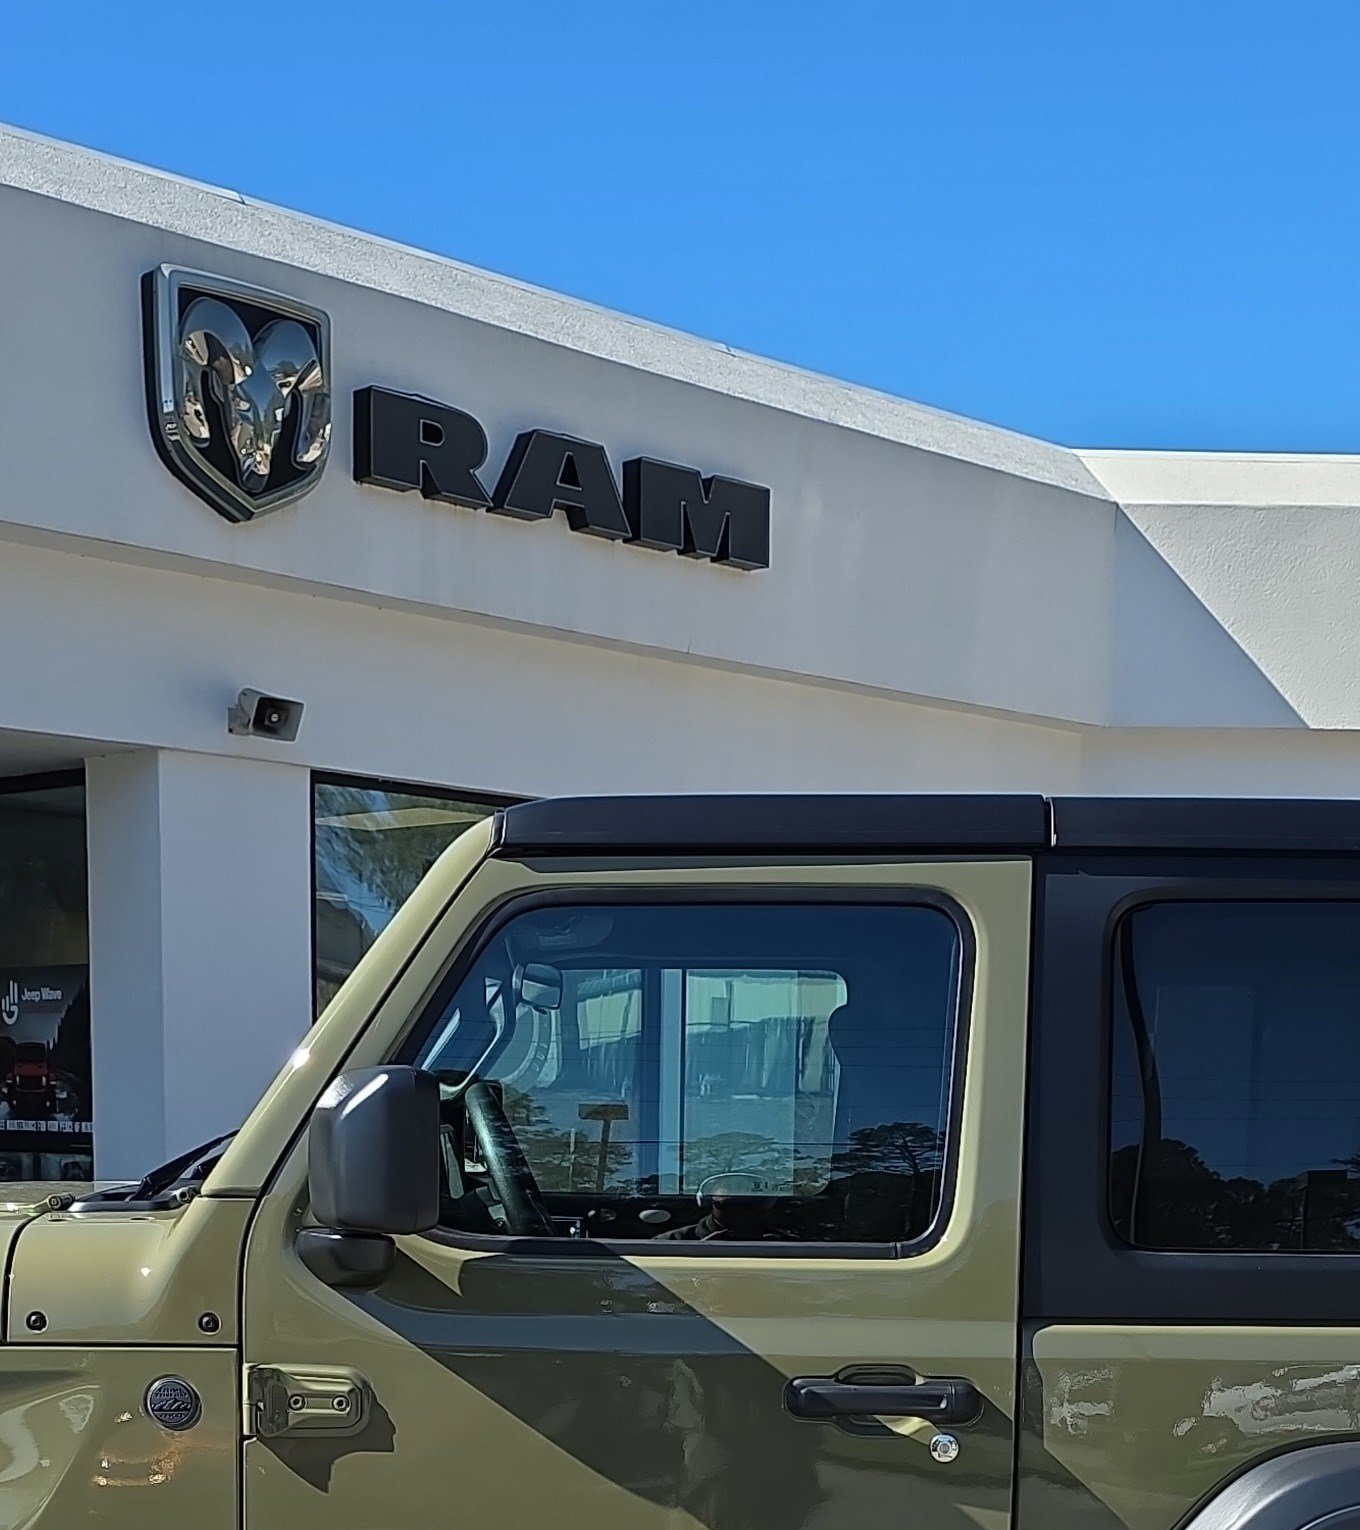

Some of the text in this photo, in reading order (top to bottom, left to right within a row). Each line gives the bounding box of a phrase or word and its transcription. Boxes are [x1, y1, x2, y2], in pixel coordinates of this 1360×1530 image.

[353, 386, 770, 571] RAM
[21, 987, 62, 1002] Jeep Wave
